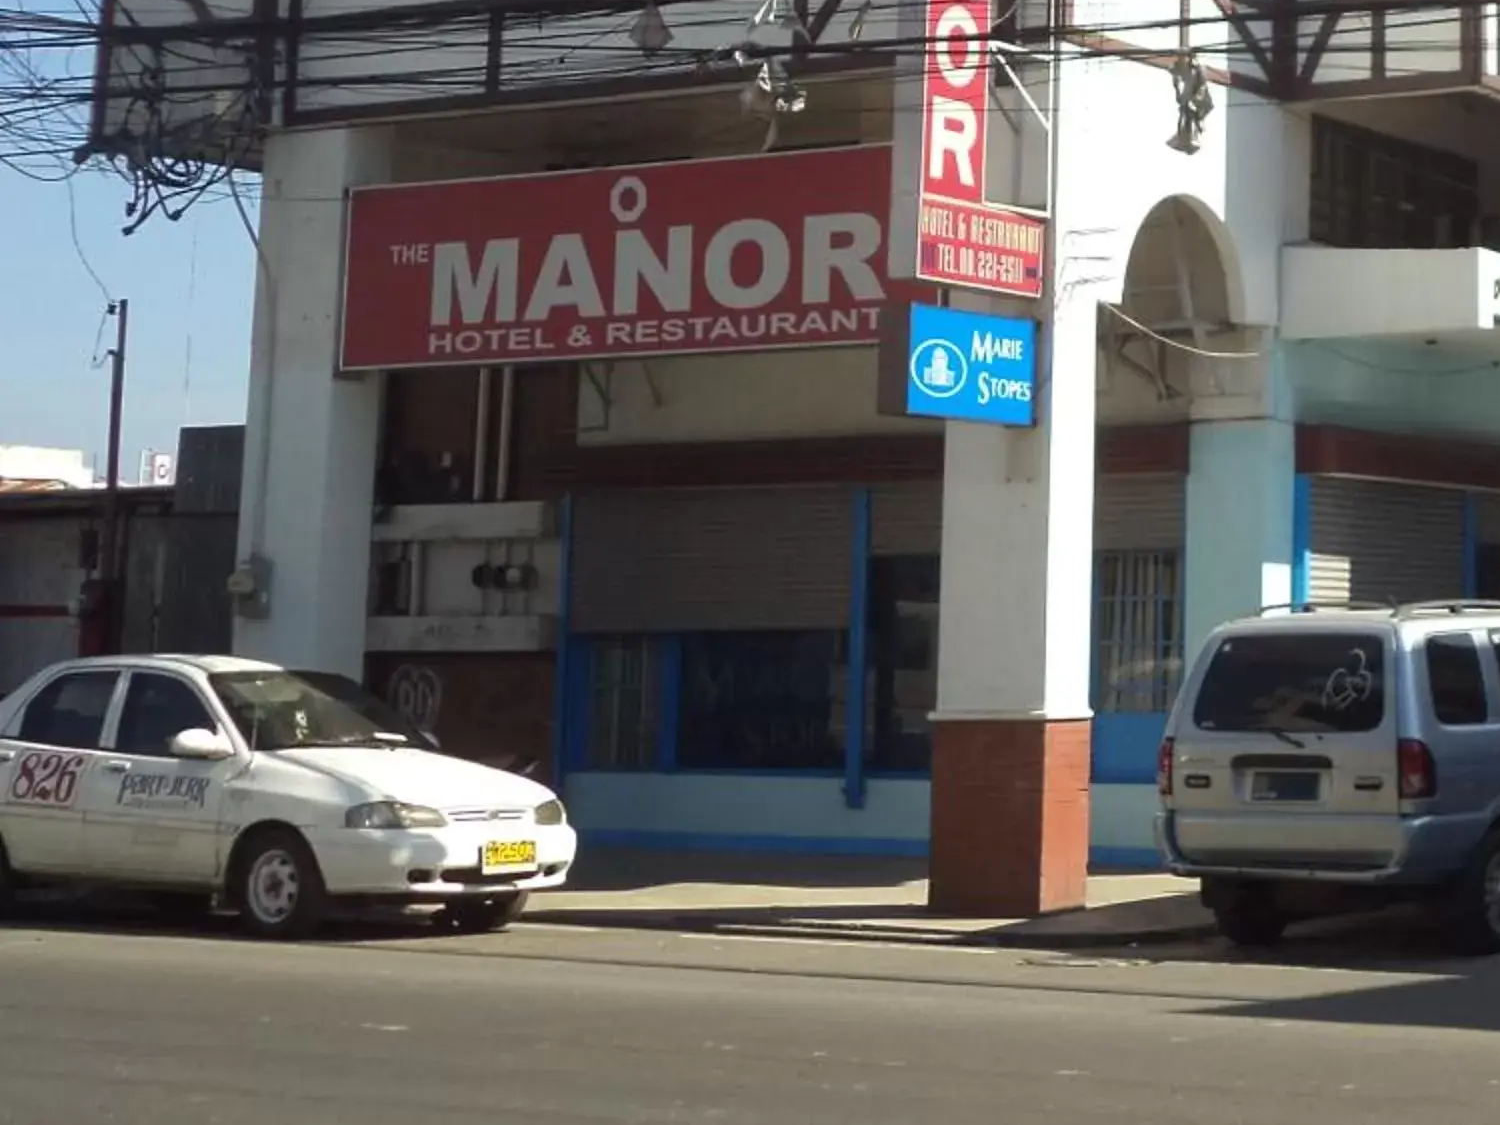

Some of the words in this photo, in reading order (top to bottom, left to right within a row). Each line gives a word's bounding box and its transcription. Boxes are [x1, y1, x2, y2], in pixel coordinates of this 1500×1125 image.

[391, 242, 429, 266] THE
[429, 212, 887, 327] MANOR
[427, 319, 555, 355] HOTEL
[567, 320, 593, 348] &
[606, 306, 881, 347] RESTAURANT
[970, 330, 1024, 364] MARIE
[977, 370, 1032, 405] STOPES
[12, 752, 85, 803] 826
